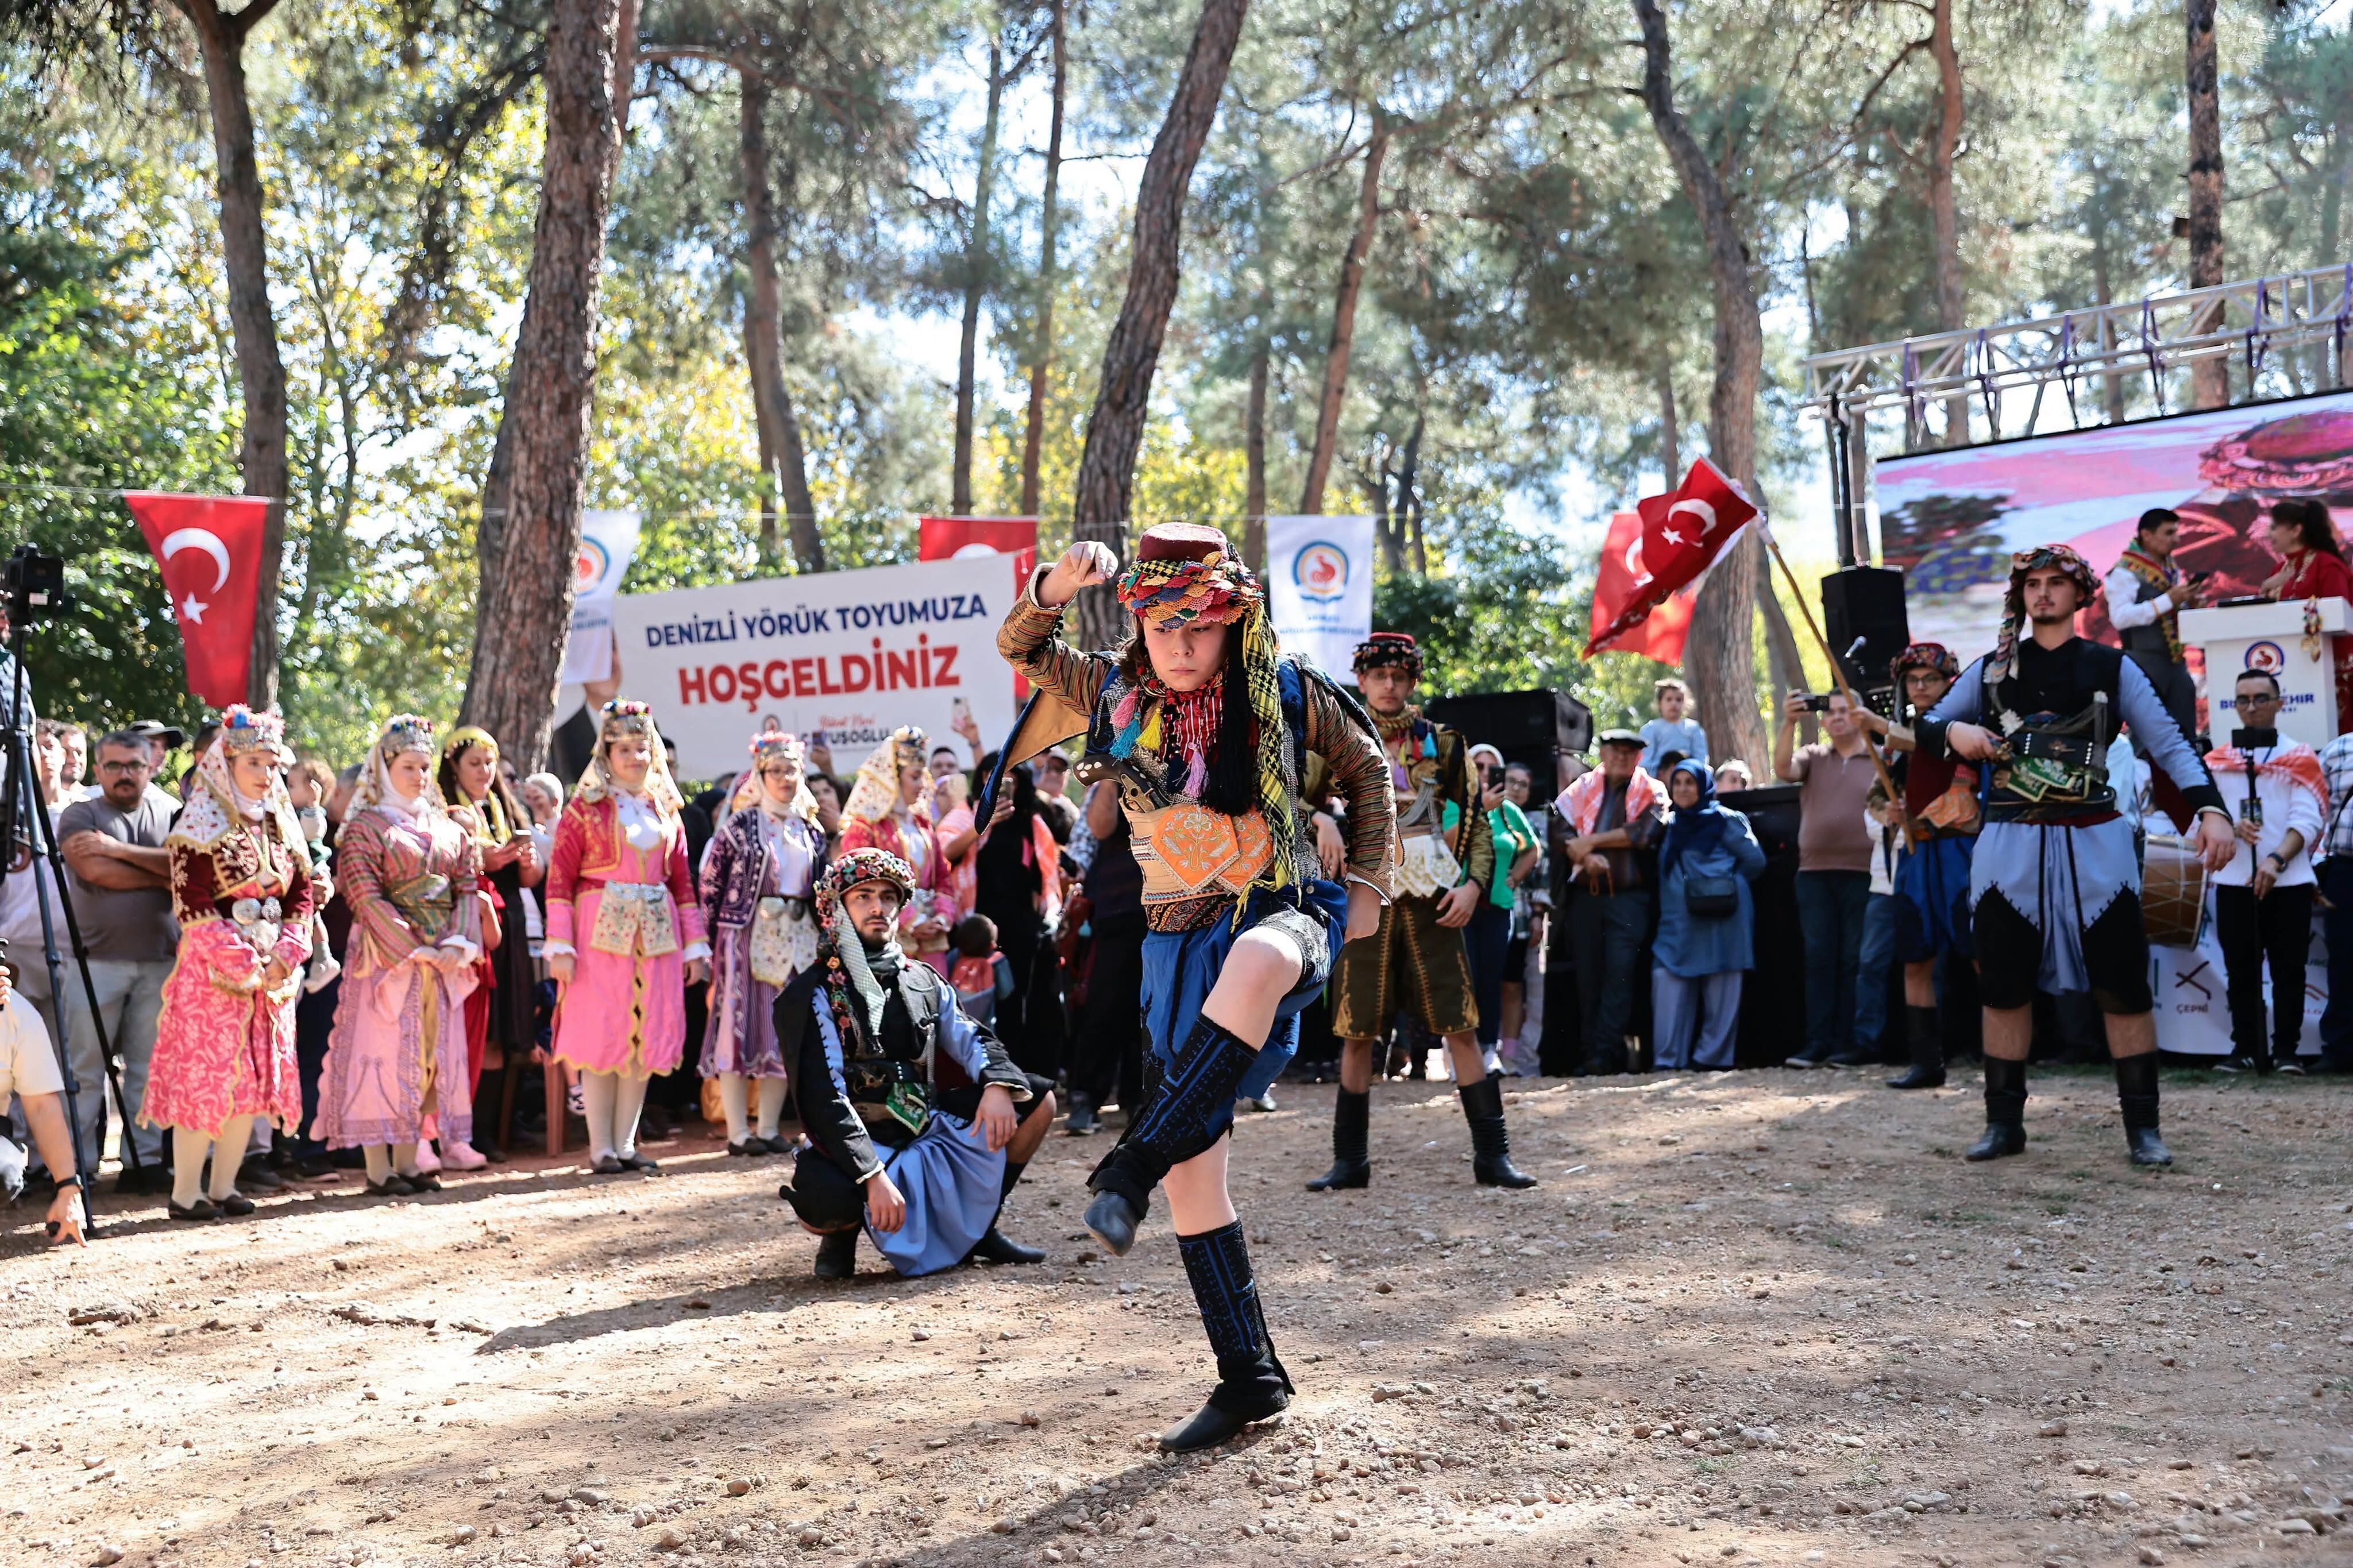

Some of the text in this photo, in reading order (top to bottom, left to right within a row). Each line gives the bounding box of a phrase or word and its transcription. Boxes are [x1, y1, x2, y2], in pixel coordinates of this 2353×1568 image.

[646, 594, 987, 647] DENİZLİ YÖRÜK TOYUMUZA
[678, 633, 961, 713] HOŞGELDİNİZ
